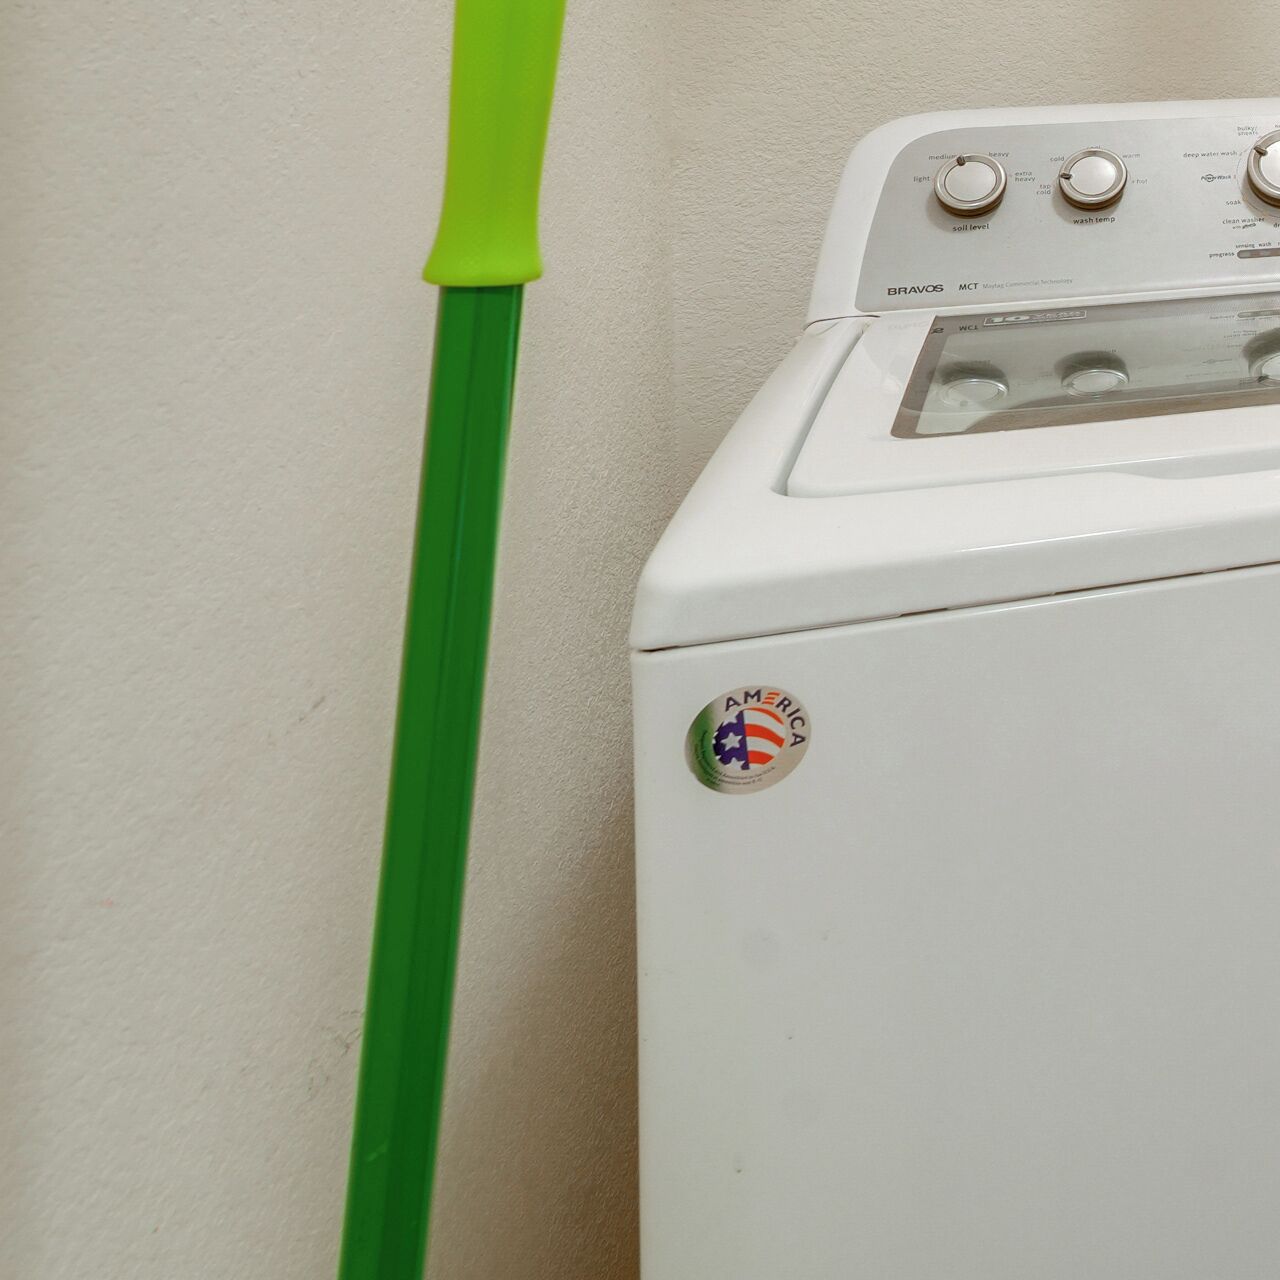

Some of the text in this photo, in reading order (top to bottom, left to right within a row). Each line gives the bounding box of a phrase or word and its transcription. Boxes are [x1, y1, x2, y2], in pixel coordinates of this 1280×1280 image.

[914, 175, 931, 183] light
[1094, 216, 1116, 224] temp
[952, 223, 990, 232] soil level
[887, 284, 945, 296] BRAVOS
[959, 283, 980, 291] MCT
[725, 689, 806, 748] AMERICA
